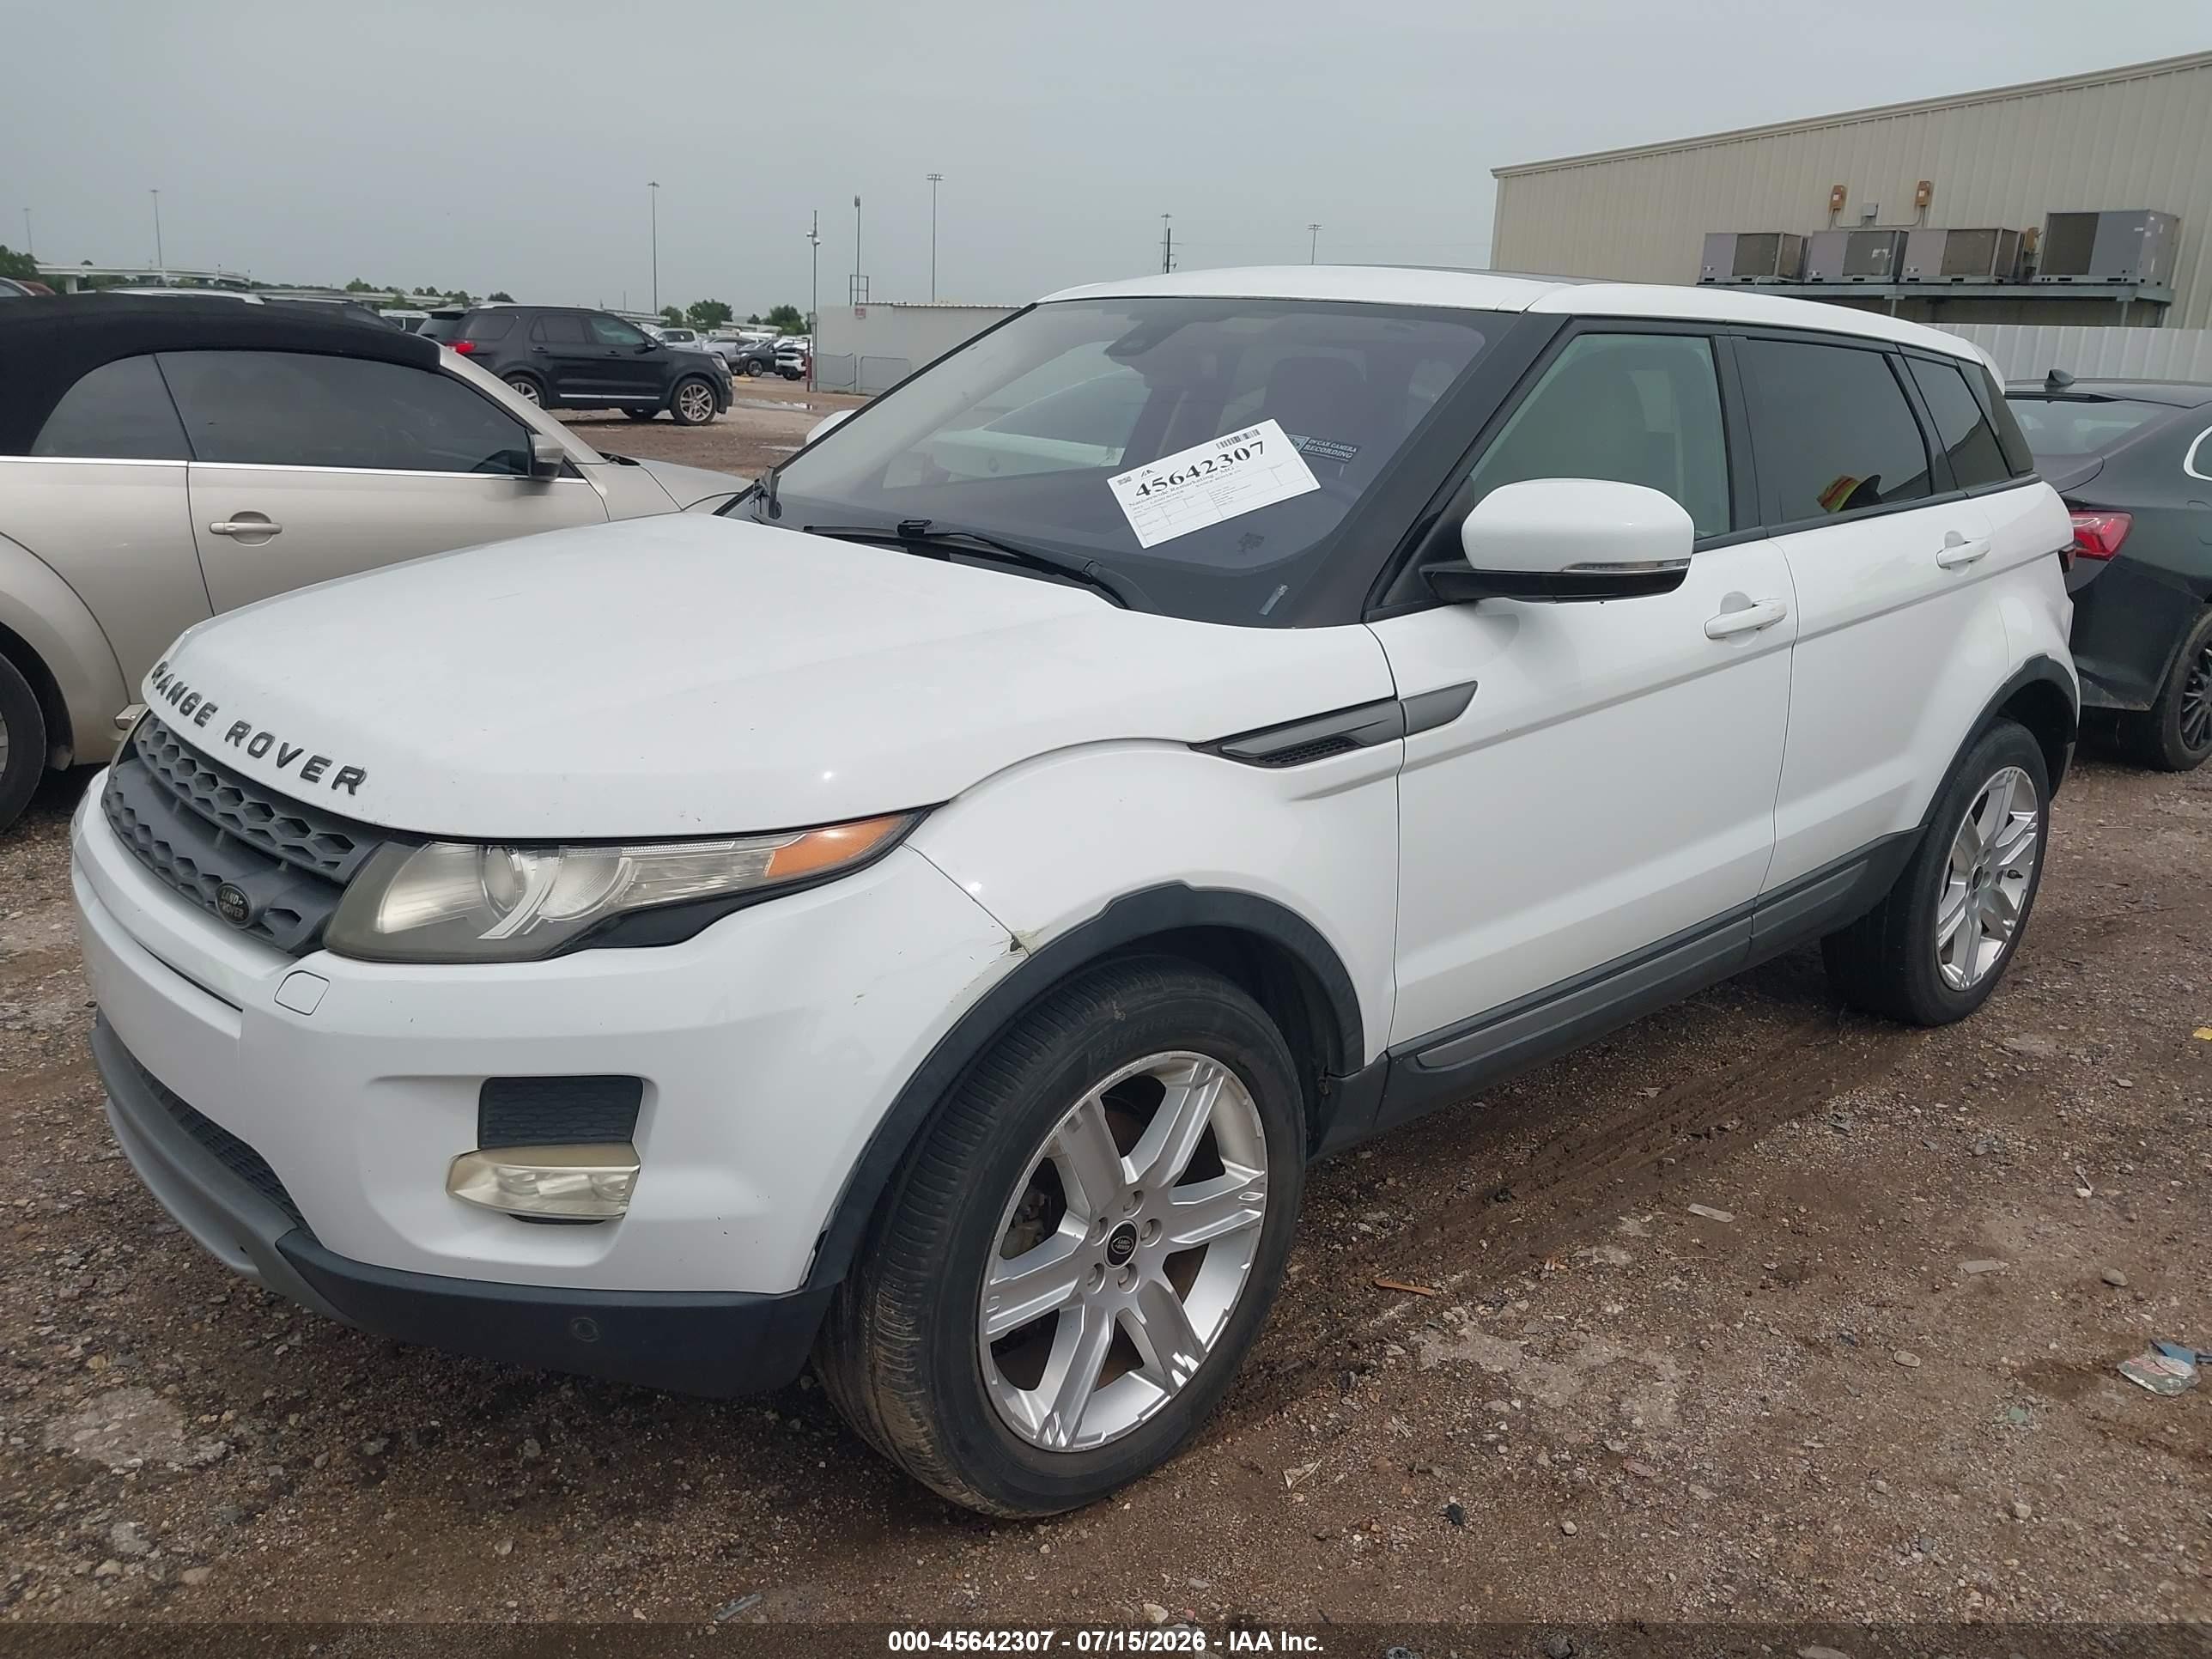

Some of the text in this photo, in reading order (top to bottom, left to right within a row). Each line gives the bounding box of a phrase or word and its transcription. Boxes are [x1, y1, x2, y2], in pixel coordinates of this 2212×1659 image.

[1304, 445, 1353, 459] RECORDING
[1331, 442, 1357, 453] CAMERA
[1136, 441, 1263, 496] 45642307
[151, 660, 368, 795] RANGE ROVER
